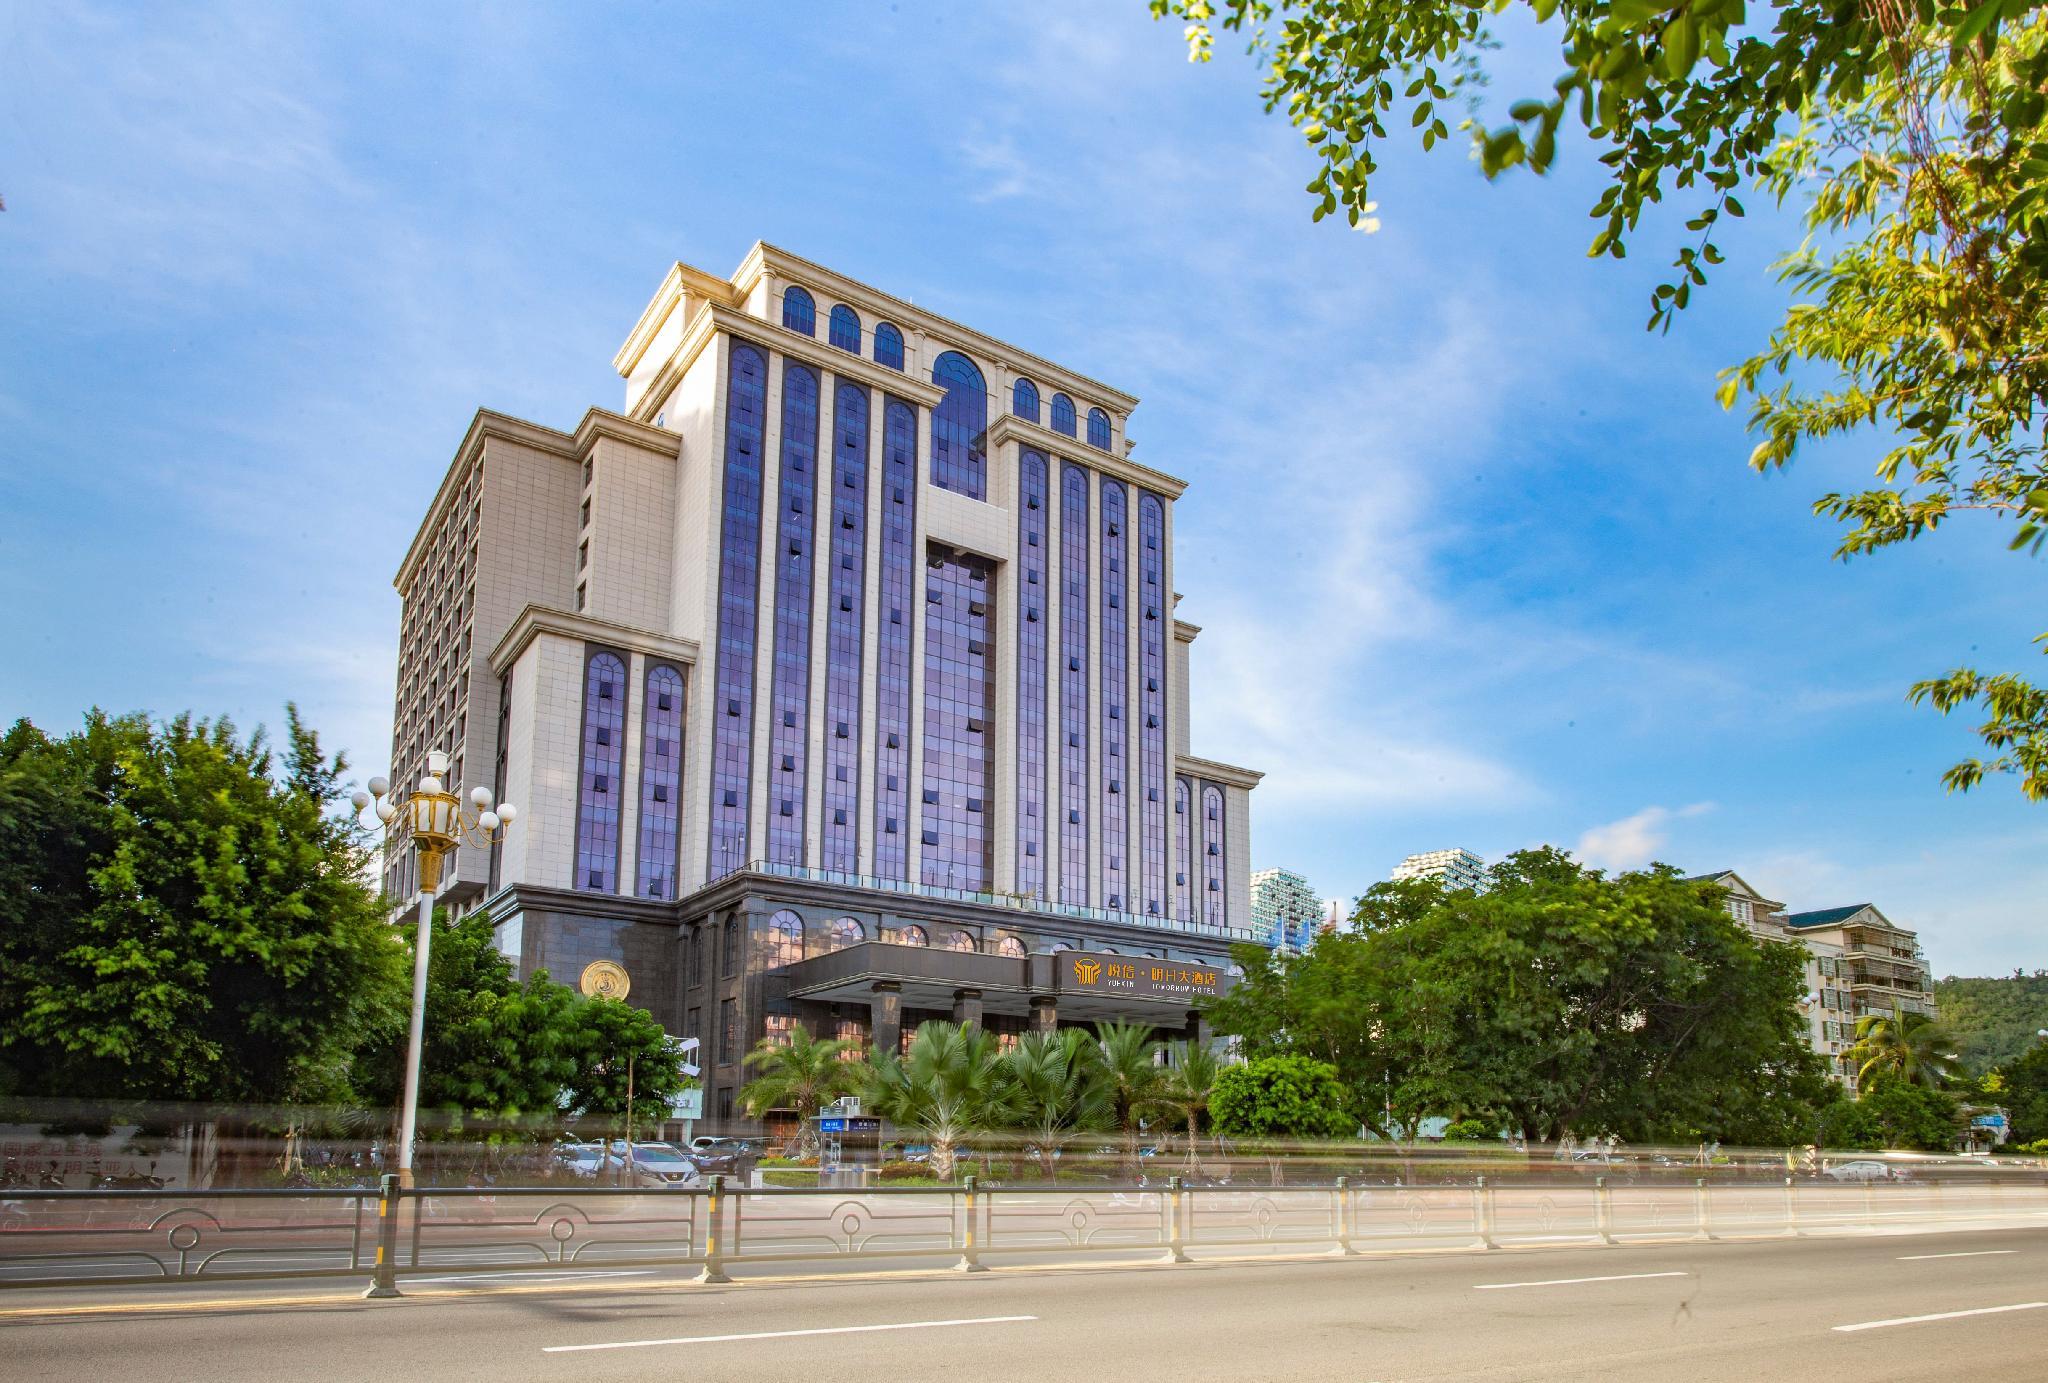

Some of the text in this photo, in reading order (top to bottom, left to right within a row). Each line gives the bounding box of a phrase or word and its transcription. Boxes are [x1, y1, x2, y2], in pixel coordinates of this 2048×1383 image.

[1151, 967, 1216, 985] 明日大酒店
[1192, 986, 1216, 995] HOTEL
